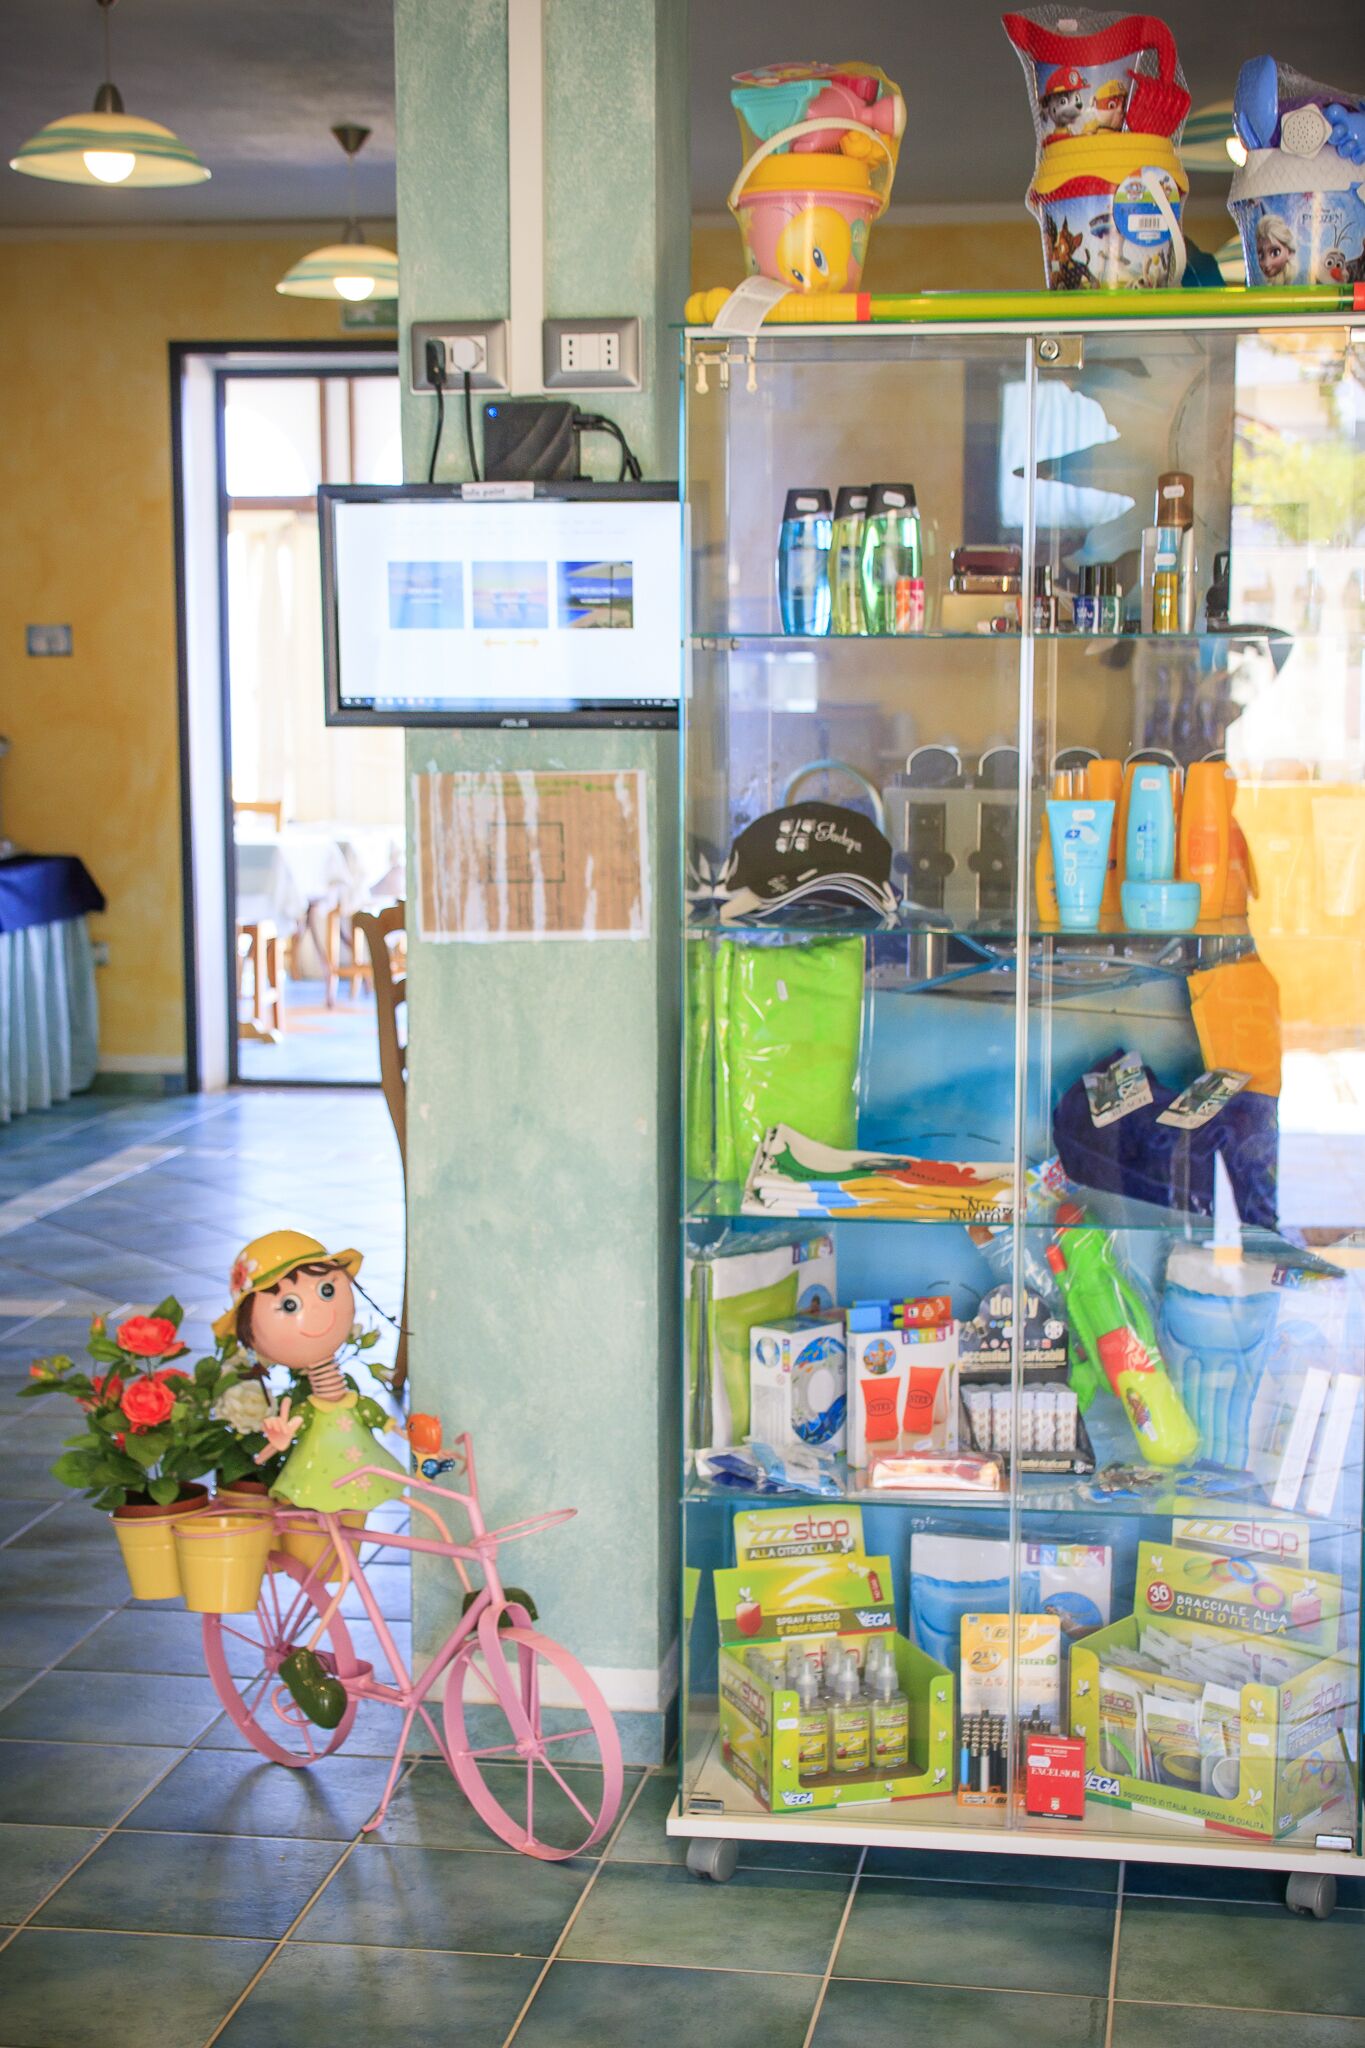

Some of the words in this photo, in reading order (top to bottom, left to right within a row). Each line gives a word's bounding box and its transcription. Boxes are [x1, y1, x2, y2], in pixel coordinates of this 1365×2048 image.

[1063, 840, 1077, 887] sun
[901, 1328, 946, 1345] INTEX
[1027, 1545, 1105, 1567] INTEX
[1149, 1583, 1170, 1602] 36
[1176, 1594, 1247, 1617] BRACCIALE
[1253, 1609, 1288, 1625] ALLA
[776, 1615, 804, 1626] SPRAY
[806, 1612, 841, 1623] FRESCO
[786, 1621, 841, 1634] PROFUMATO
[855, 1610, 892, 1628] VEGA
[1175, 1604, 1288, 1635] CITRONELLA
[1031, 1766, 1080, 1779] EXCELSIOR
[780, 1789, 814, 1806] VEGA
